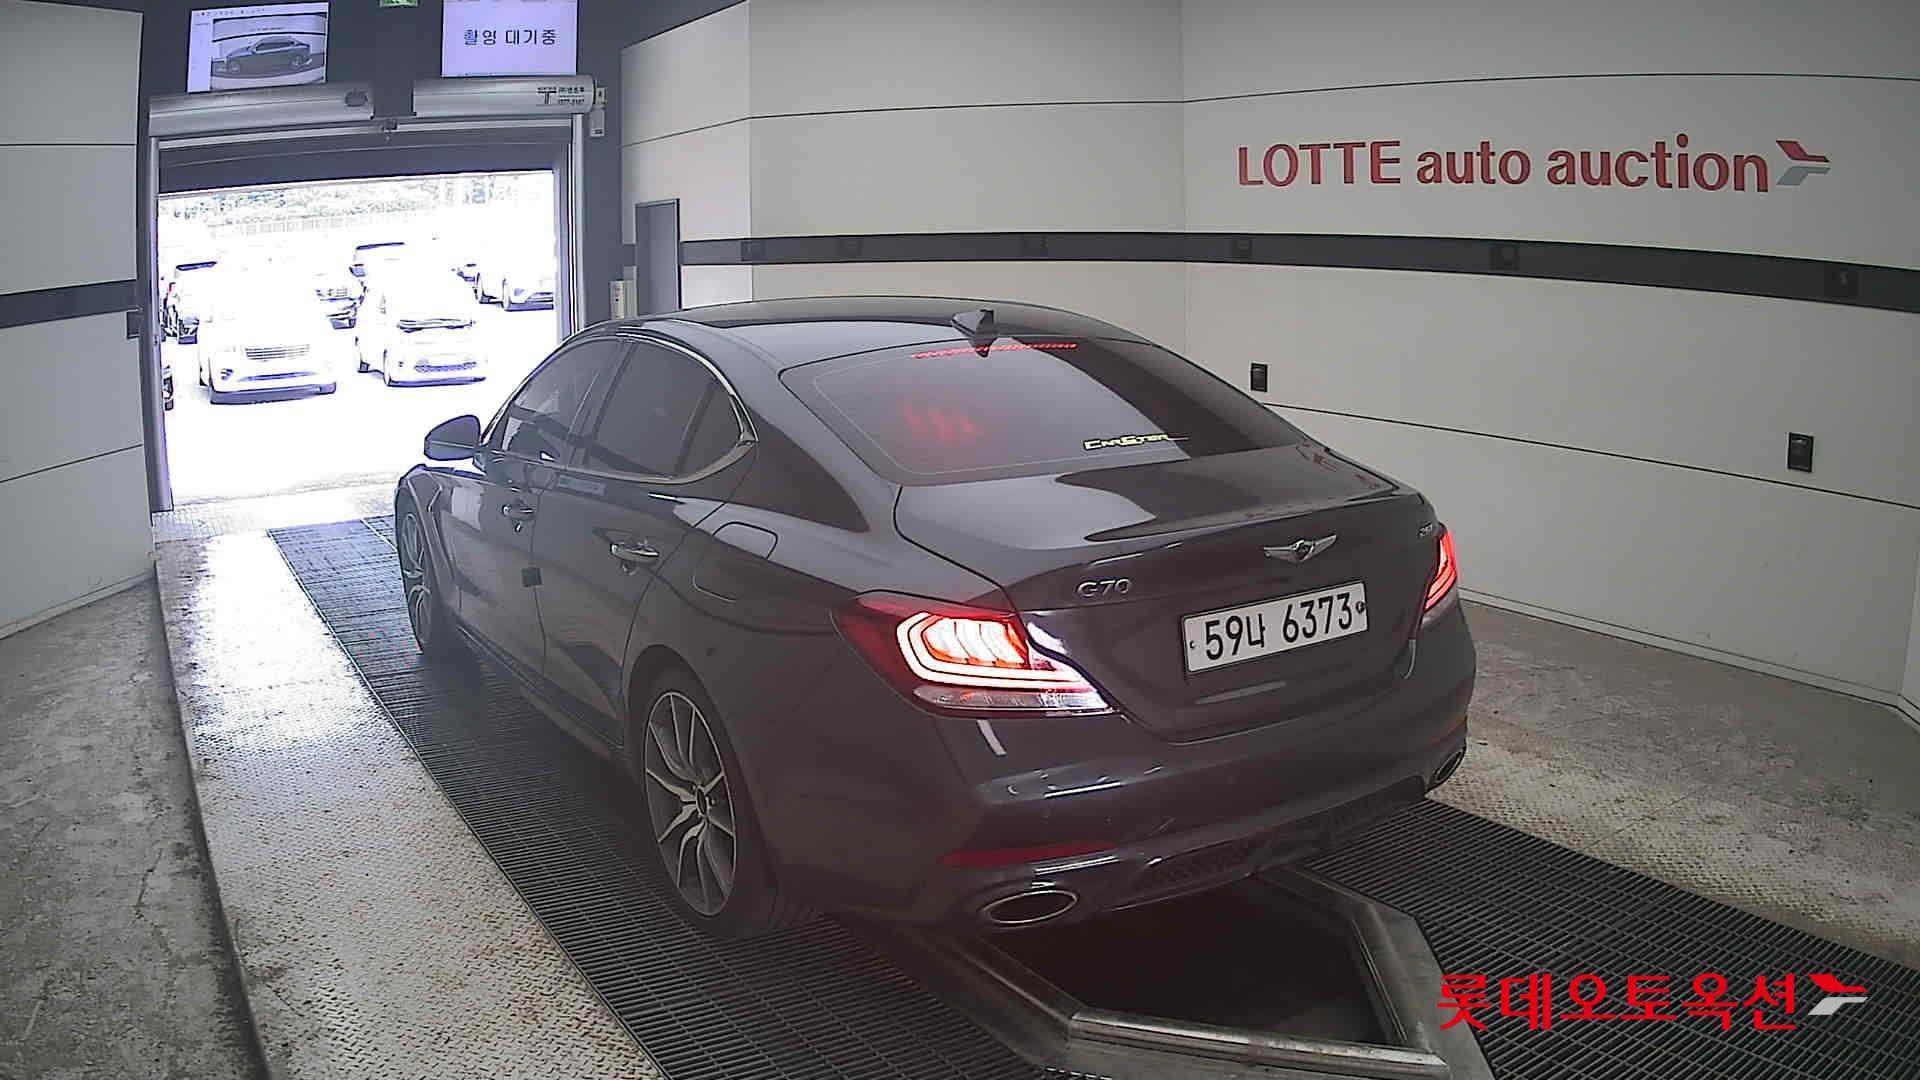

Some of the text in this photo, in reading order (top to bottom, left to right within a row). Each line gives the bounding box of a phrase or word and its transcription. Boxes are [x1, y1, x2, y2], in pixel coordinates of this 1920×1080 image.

[463, 28, 557, 46] 촬영 대기중
[1238, 132, 1769, 193] LOTTE auto auction
[1076, 577, 1132, 598] G70
[1204, 591, 1353, 661] 59나 6373
